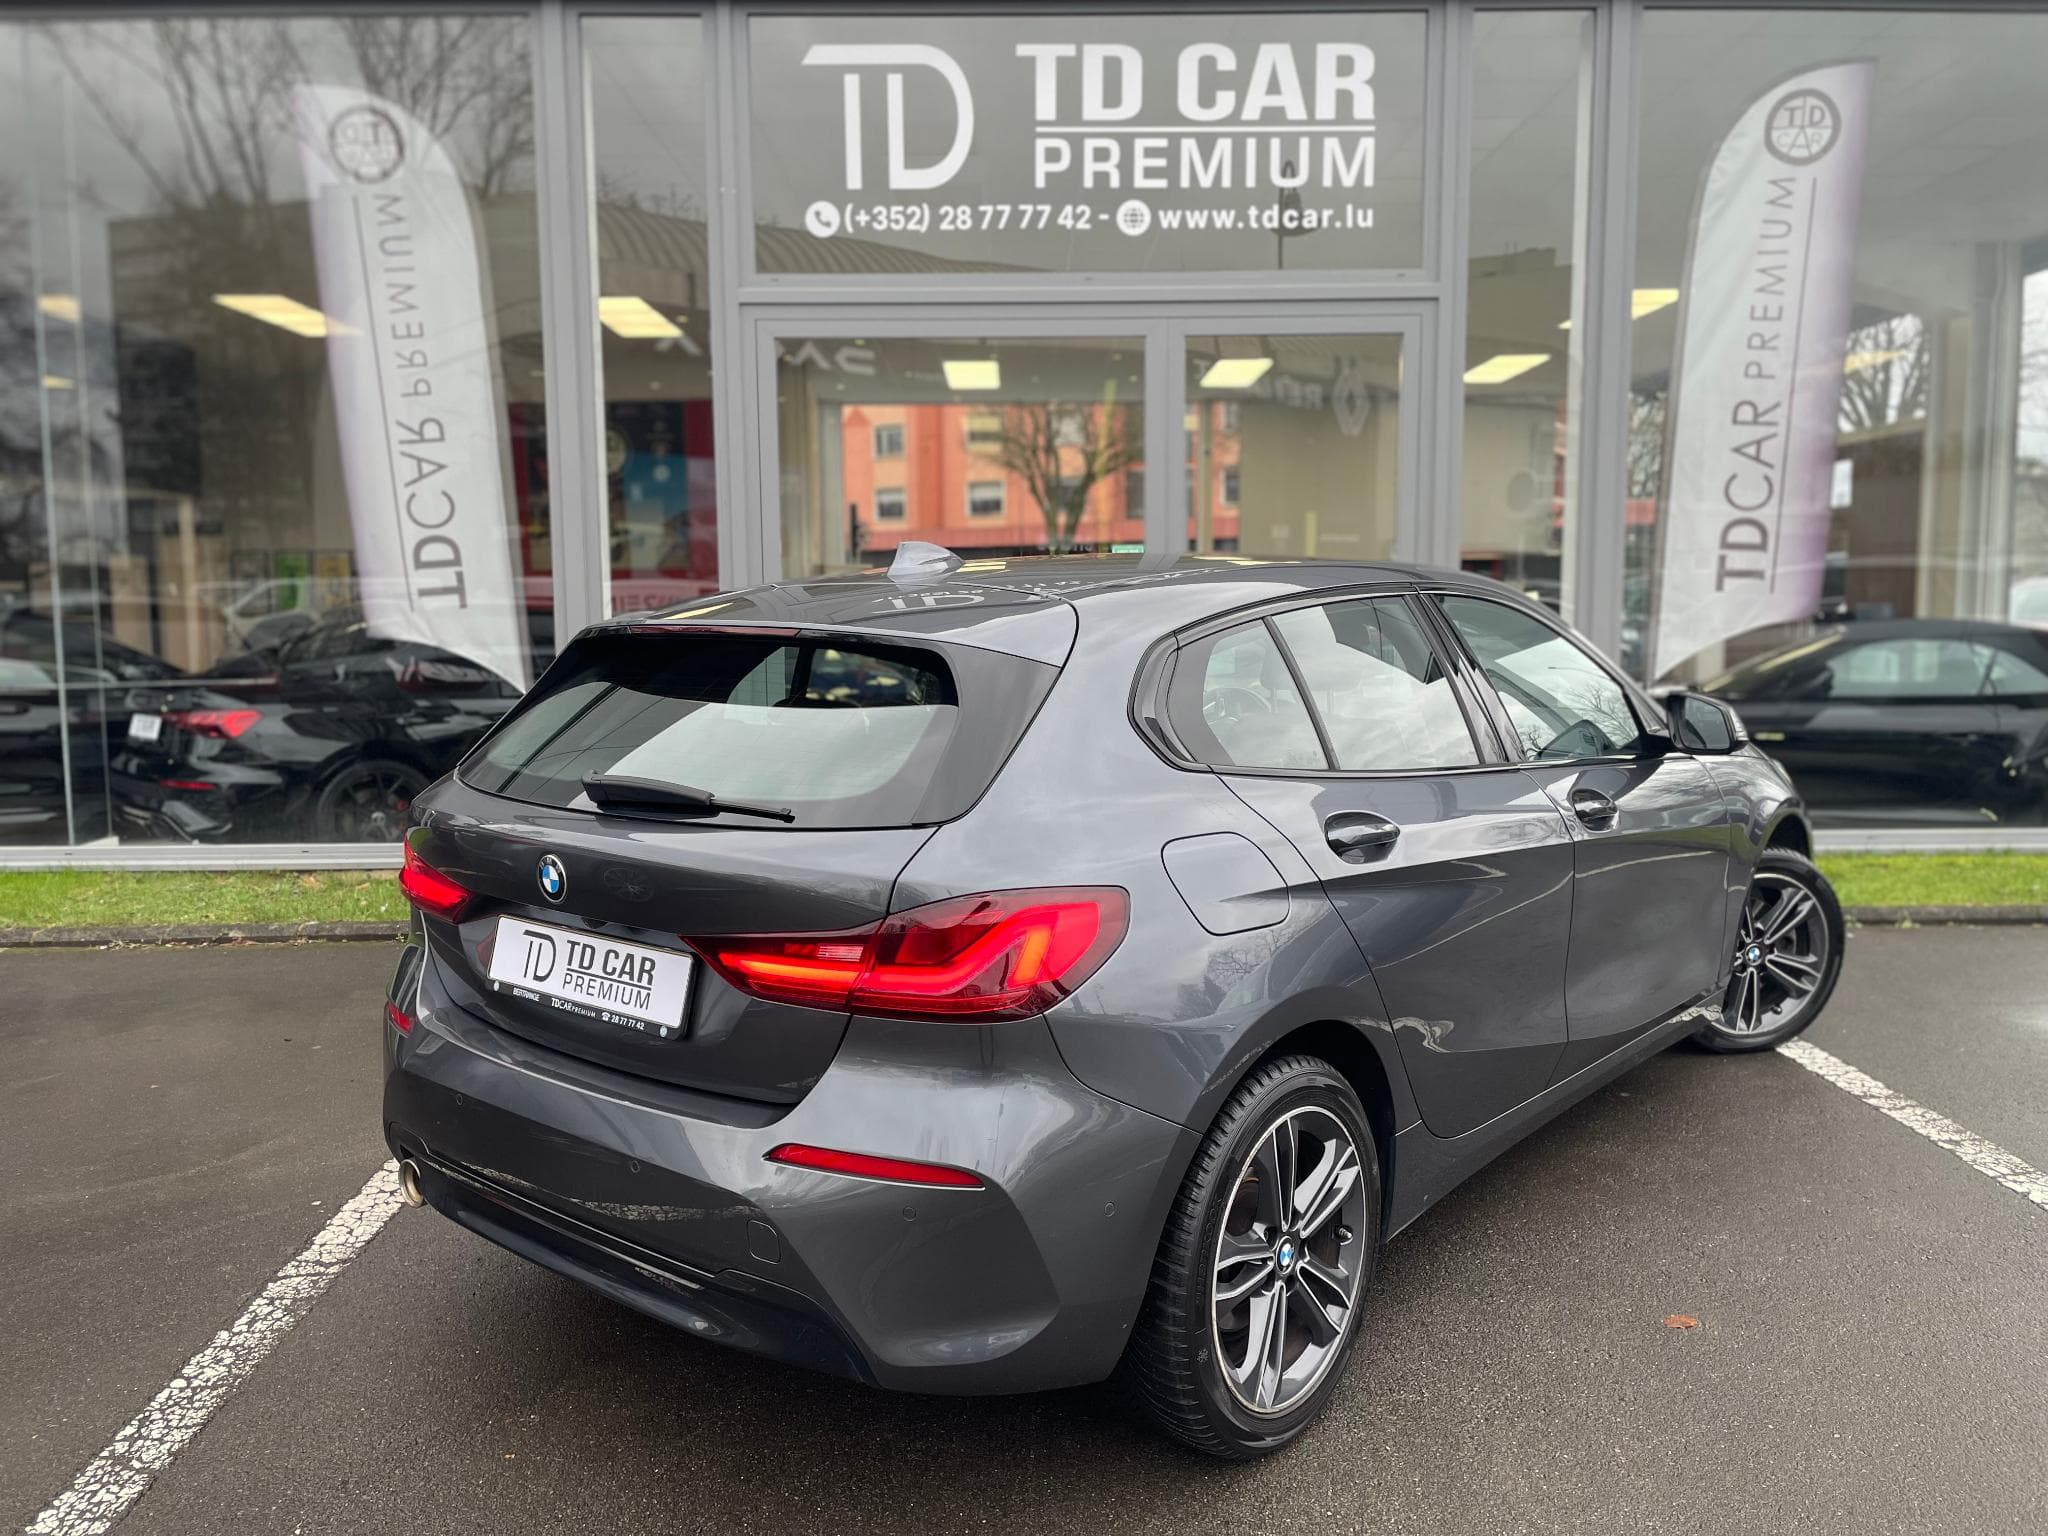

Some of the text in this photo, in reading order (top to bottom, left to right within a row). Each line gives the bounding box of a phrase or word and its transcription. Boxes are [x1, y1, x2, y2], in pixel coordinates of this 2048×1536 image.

[1016, 43, 1376, 122] TD CAR
[1035, 137, 1376, 189] PREMIUM
[844, 203, 931, 235] (+352)
[1158, 203, 1375, 231] www.tdcar.lu
[566, 939, 656, 987] TD CAR
[562, 972, 652, 1011] PREMIUM
